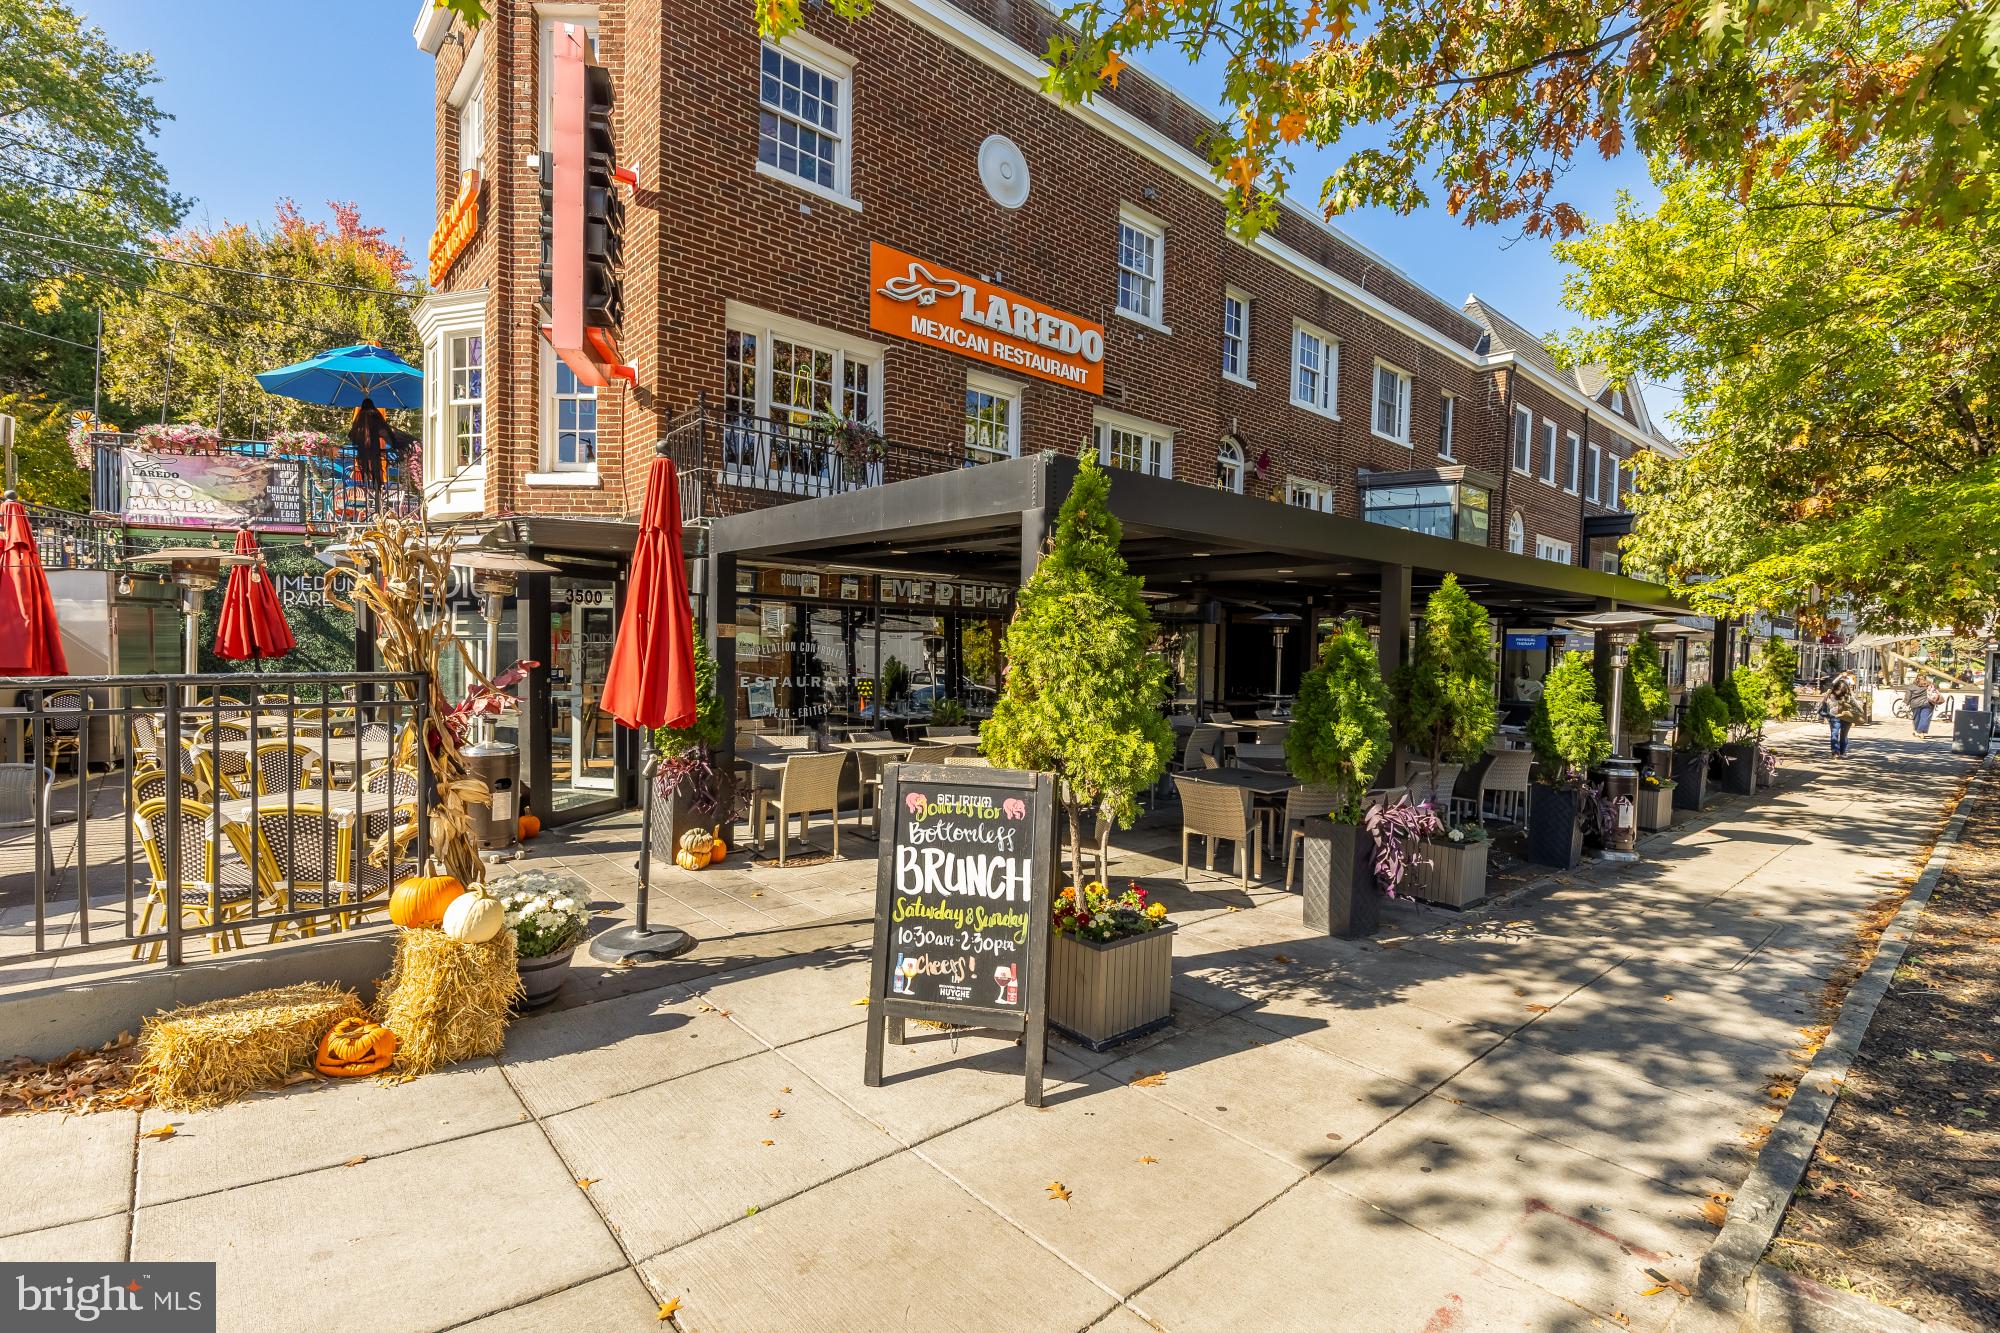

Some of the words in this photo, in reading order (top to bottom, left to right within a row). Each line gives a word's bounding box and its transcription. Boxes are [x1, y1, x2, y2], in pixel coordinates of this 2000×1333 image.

[960, 284, 1104, 363] LAREDO
[911, 315, 989, 355] MEXICAN
[992, 341, 1089, 384] RESTAURANT
[131, 468, 180, 479] LAREDO
[126, 481, 194, 499] TACO
[266, 485, 300, 495] CHICKEN
[271, 493, 300, 502] SHRIMP
[126, 496, 217, 513] MADNESS
[274, 501, 300, 510] VEGAN
[280, 510, 300, 518] EGGS
[566, 588, 603, 605] 3500
[892, 579, 1008, 605] MEDIUM
[937, 793, 992, 808] DELIRIUM
[908, 819, 1016, 852] Bottomless
[896, 845, 1032, 902] BRUNCH
[892, 896, 963, 929] Saturday
[974, 906, 1028, 945] Sunday
[939, 987, 971, 999] HUYGHE
